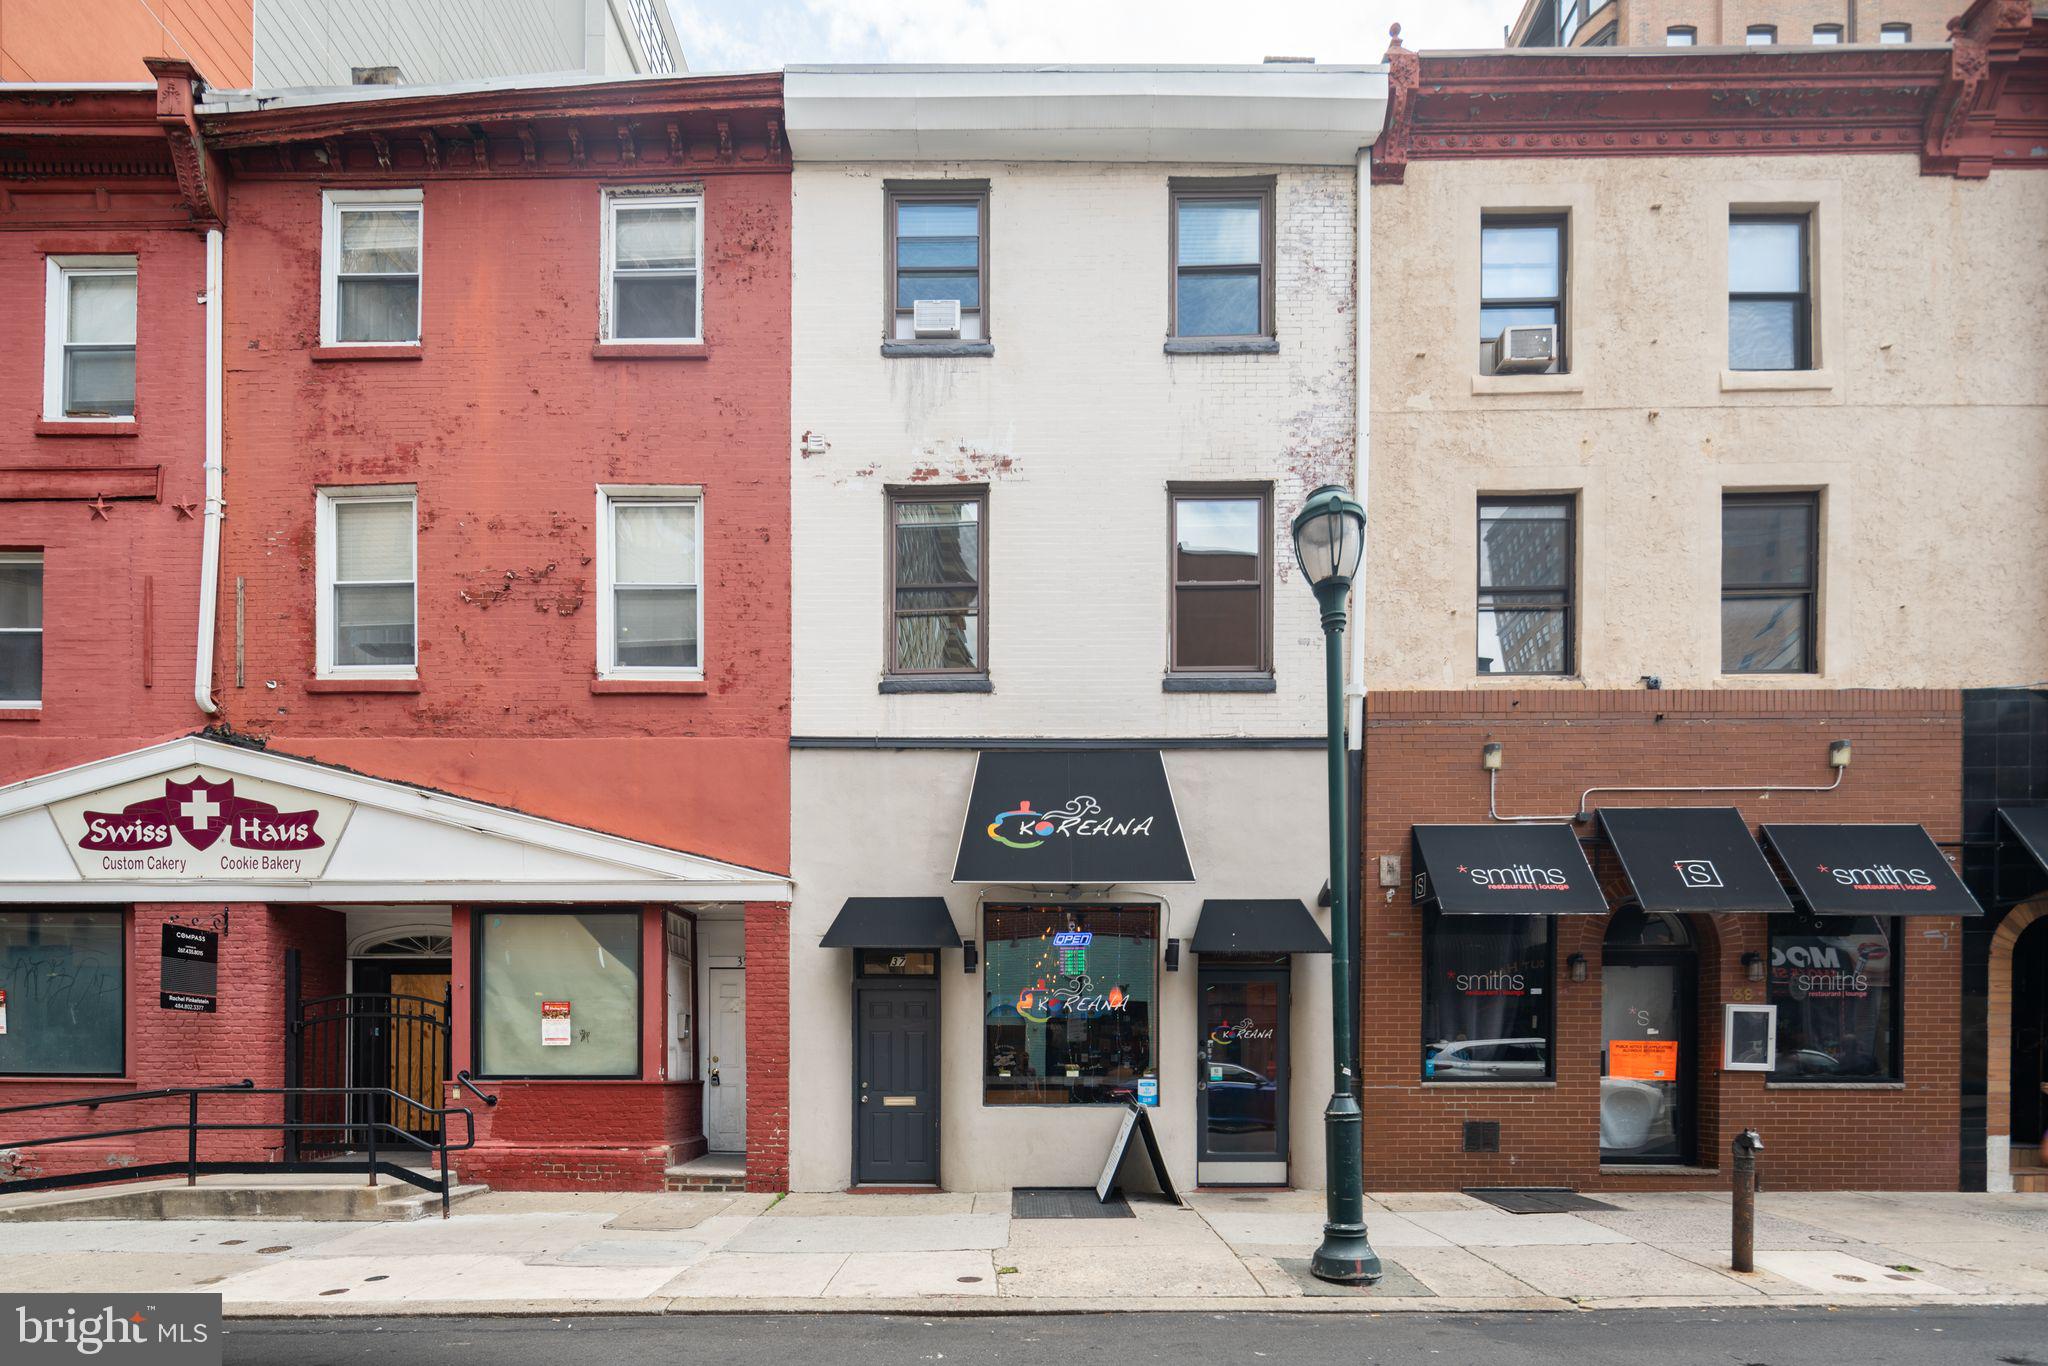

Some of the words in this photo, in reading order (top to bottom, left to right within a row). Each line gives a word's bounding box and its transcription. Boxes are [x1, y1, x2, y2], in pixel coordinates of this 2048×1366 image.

[90, 818, 168, 843] Swiss
[240, 817, 309, 842] Haus
[102, 856, 144, 870] Custom
[147, 856, 187, 873] Cakery
[220, 856, 259, 870] Cookie
[262, 856, 301, 873] Bakery
[1687, 864, 1711, 883] S
[1538, 883, 1570, 891] lounge
[1905, 883, 1937, 891] lounge
[176, 931, 206, 942] COMPASS
[1056, 934, 1090, 946] OPEN
[891, 957, 906, 967] 37
[1798, 970, 1868, 991] smiths
[168, 995, 186, 1003] Rachel
